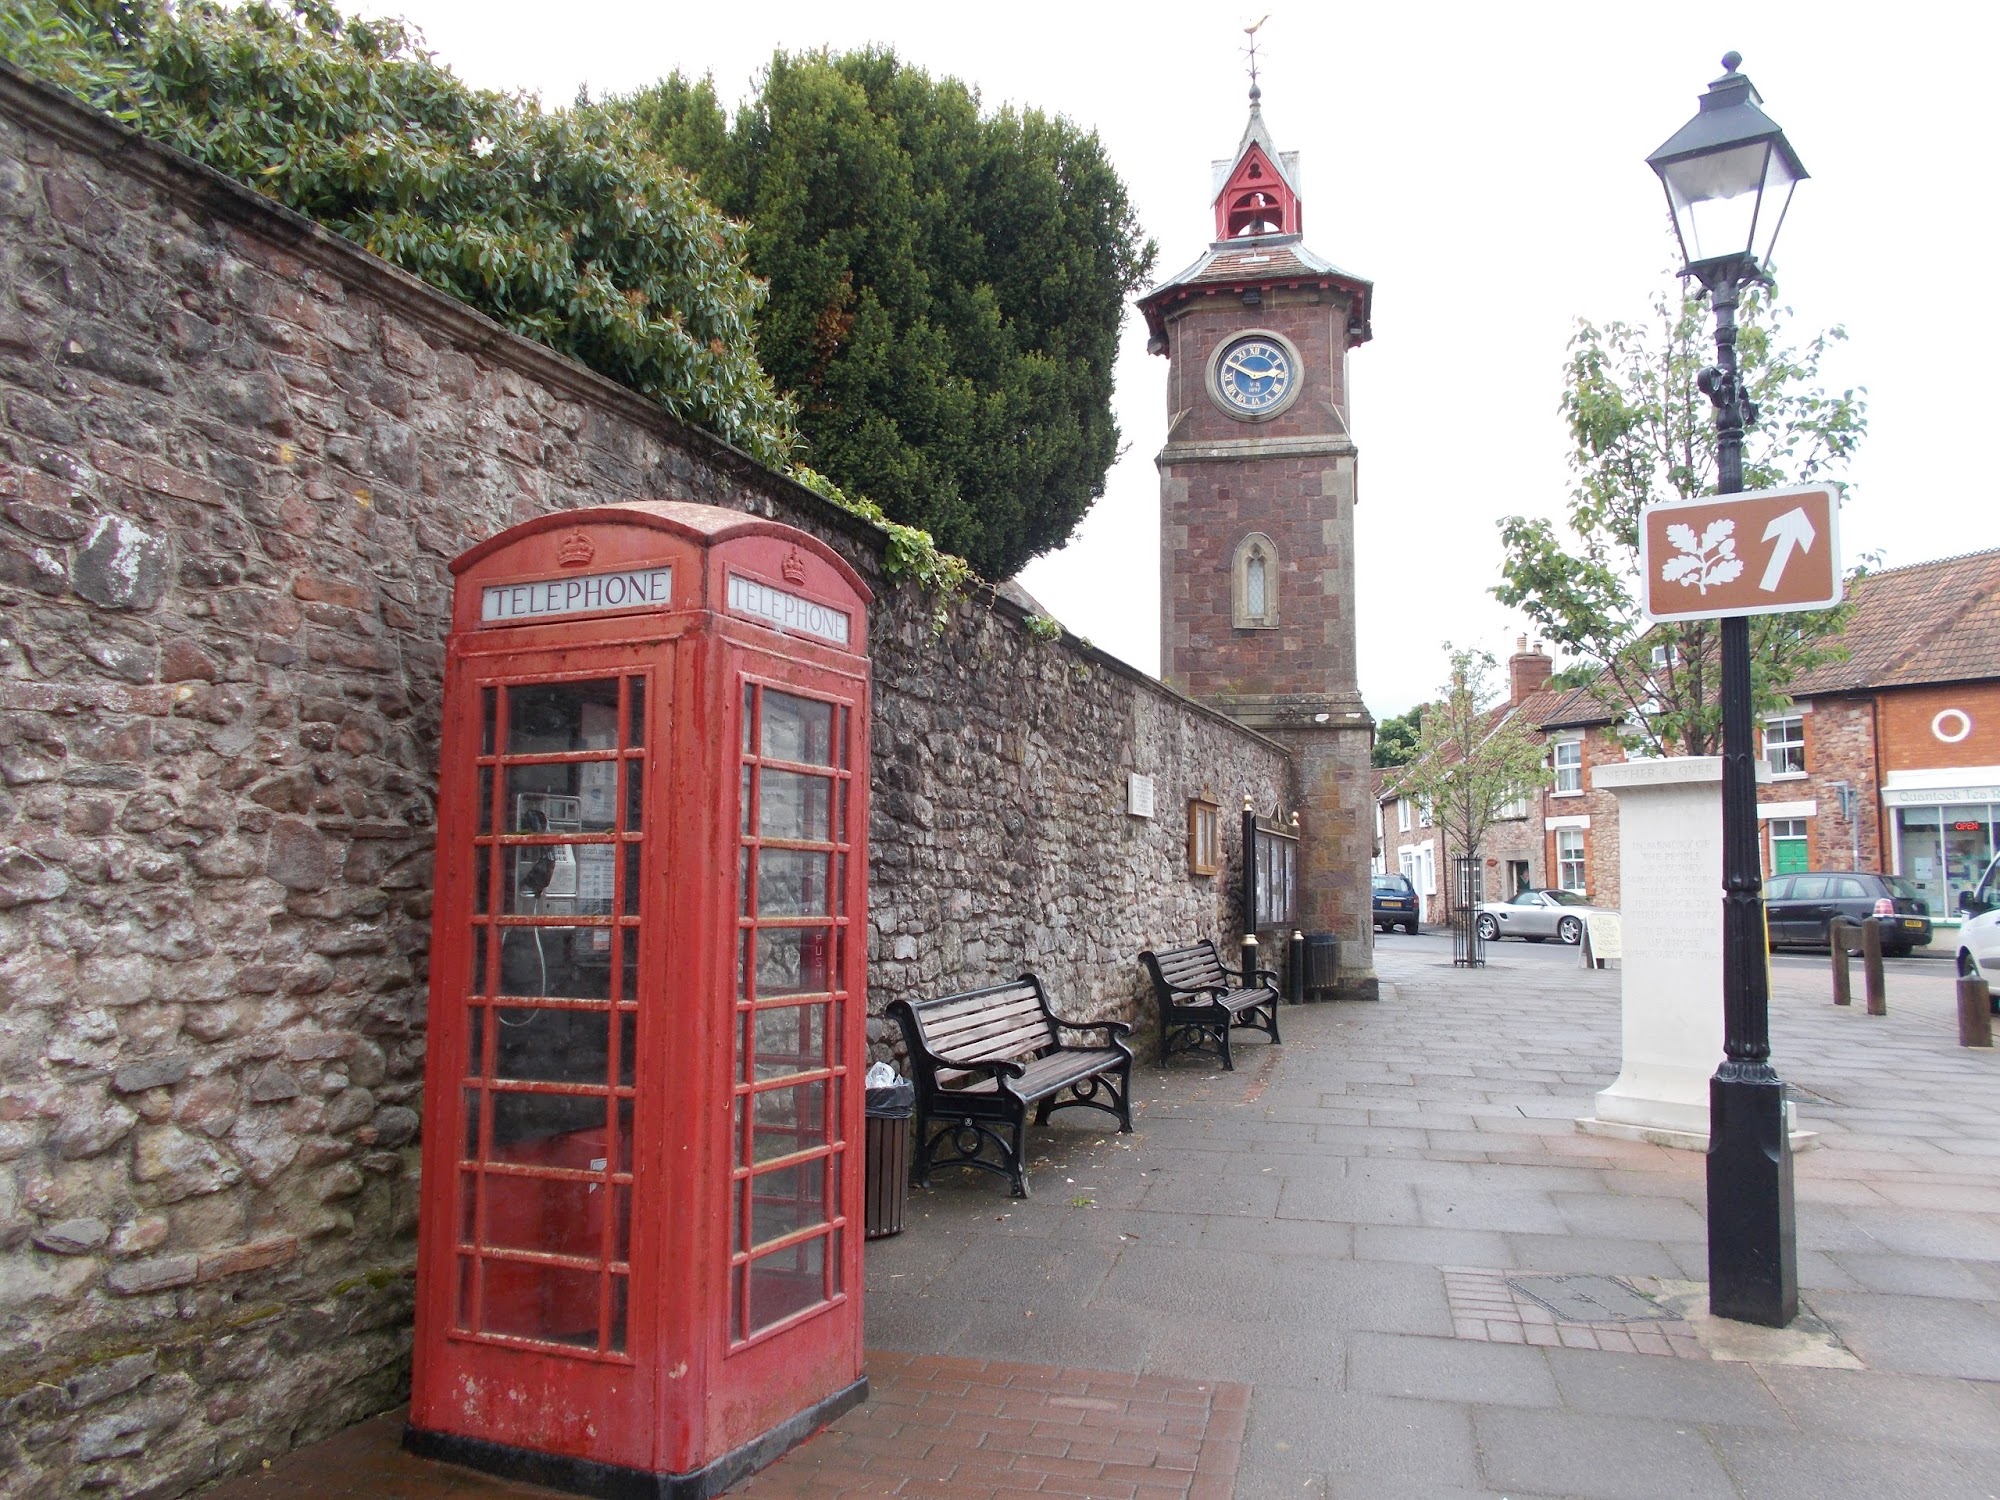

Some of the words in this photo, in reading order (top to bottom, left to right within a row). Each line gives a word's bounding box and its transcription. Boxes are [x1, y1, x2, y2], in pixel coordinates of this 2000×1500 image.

[492, 572, 666, 616] TELEPHONE
[730, 577, 846, 641] TELEPHONE
[1604, 766, 1655, 780] NETHER
[1661, 766, 1672, 776] &
[1899, 790, 1961, 802] Quantock
[1966, 789, 1987, 800] Tea
[1955, 822, 1978, 830] OPEN
[1647, 840, 1694, 849] MEMORY
[815, 934, 823, 979] PUSH
